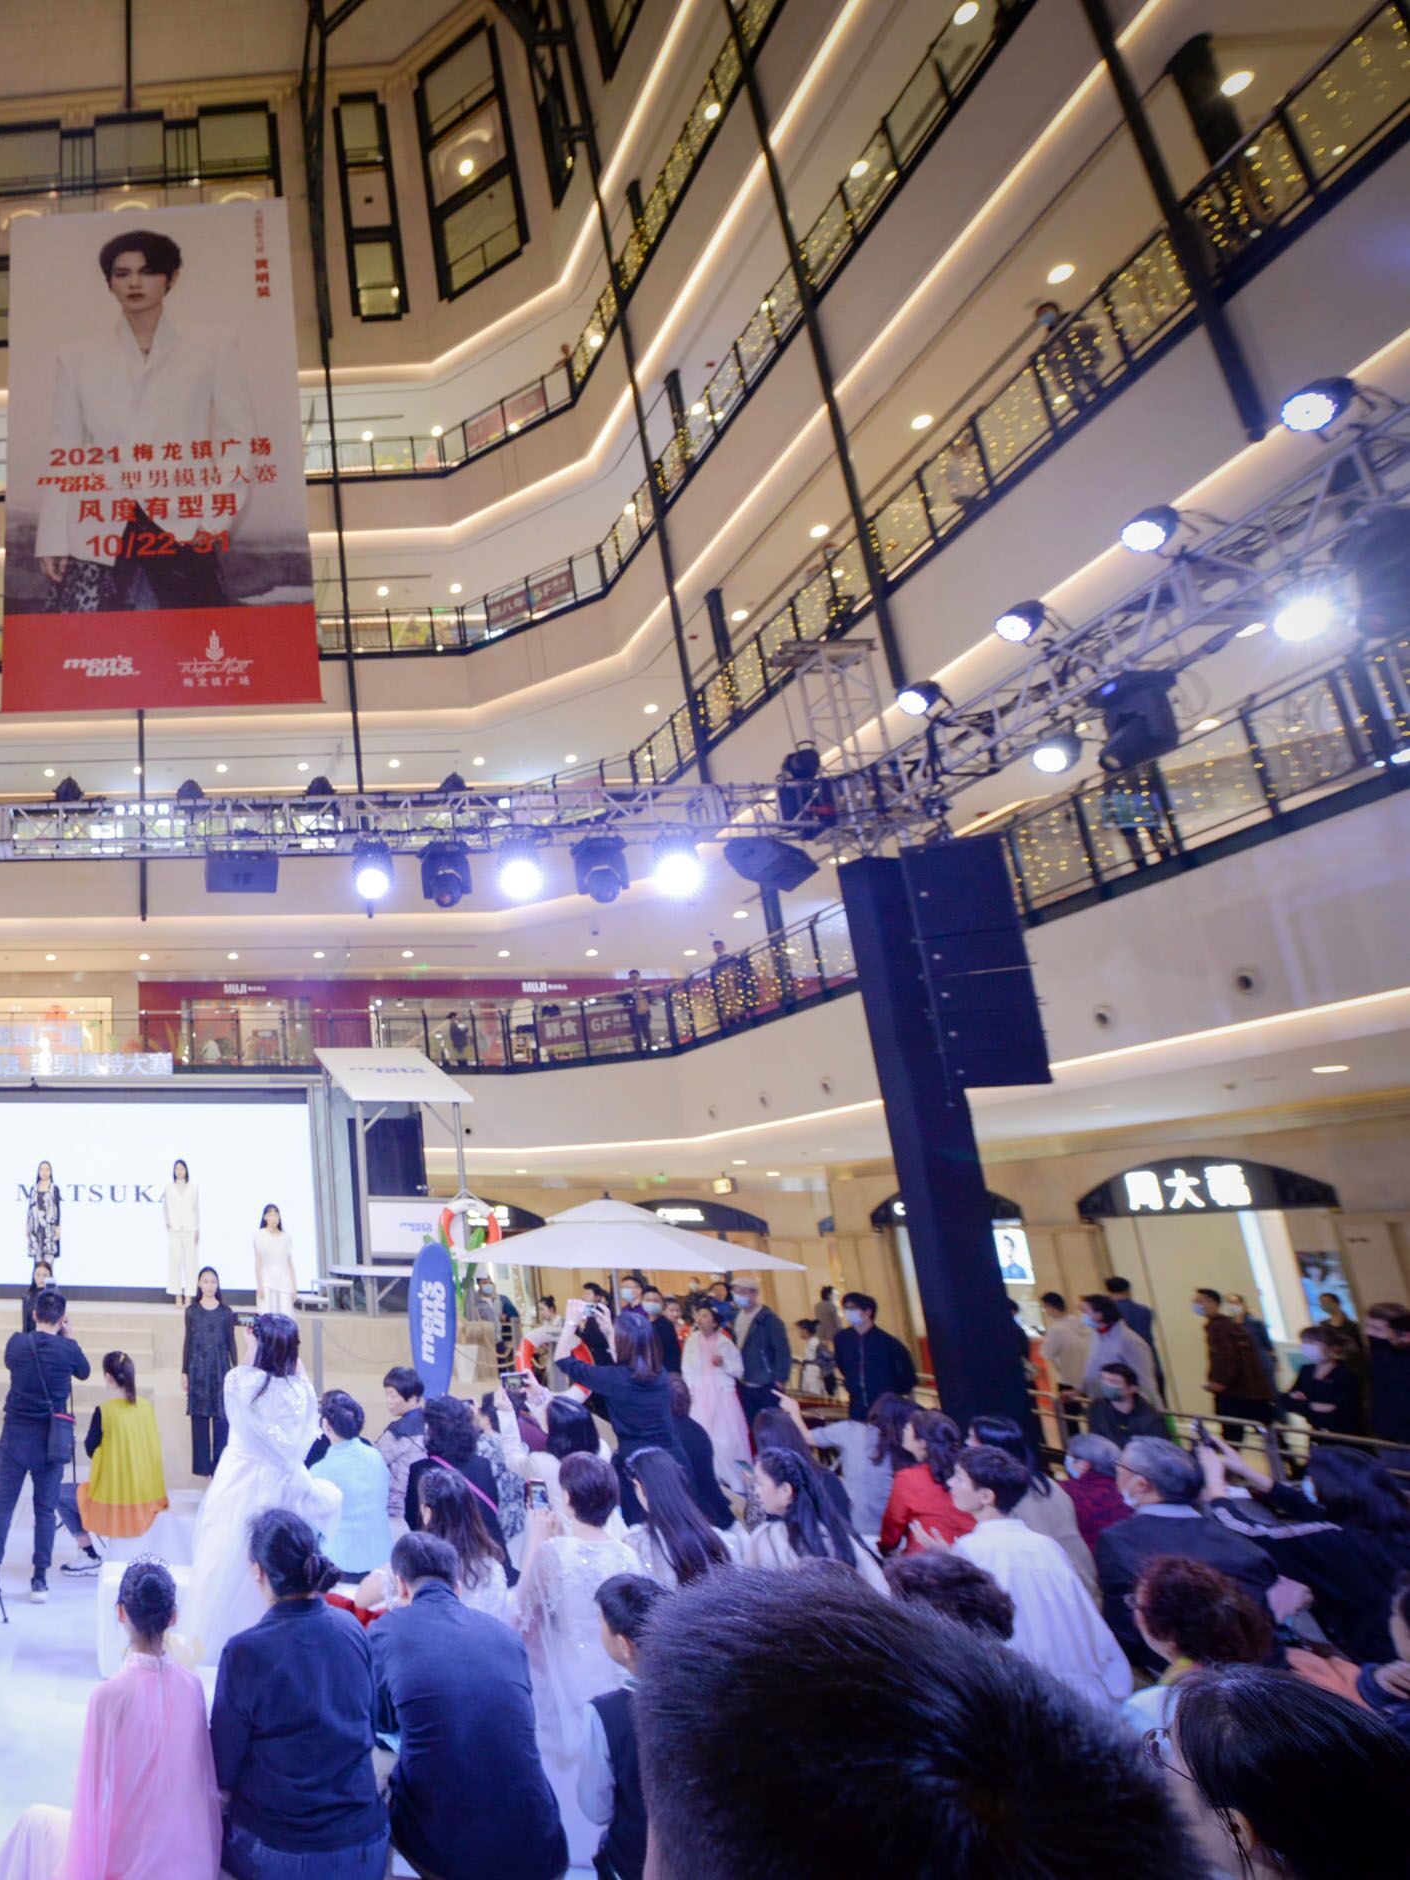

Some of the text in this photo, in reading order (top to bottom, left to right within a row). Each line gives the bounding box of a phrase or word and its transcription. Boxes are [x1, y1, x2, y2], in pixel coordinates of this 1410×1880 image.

[50, 436, 272, 467] 2021 梅龙镇广场
[120, 464, 278, 490] 型男模特大赛
[77, 493, 238, 524] 风度有型男
[16, 1183, 167, 1203] MTSUK
[418, 1281, 446, 1363] men's uno
